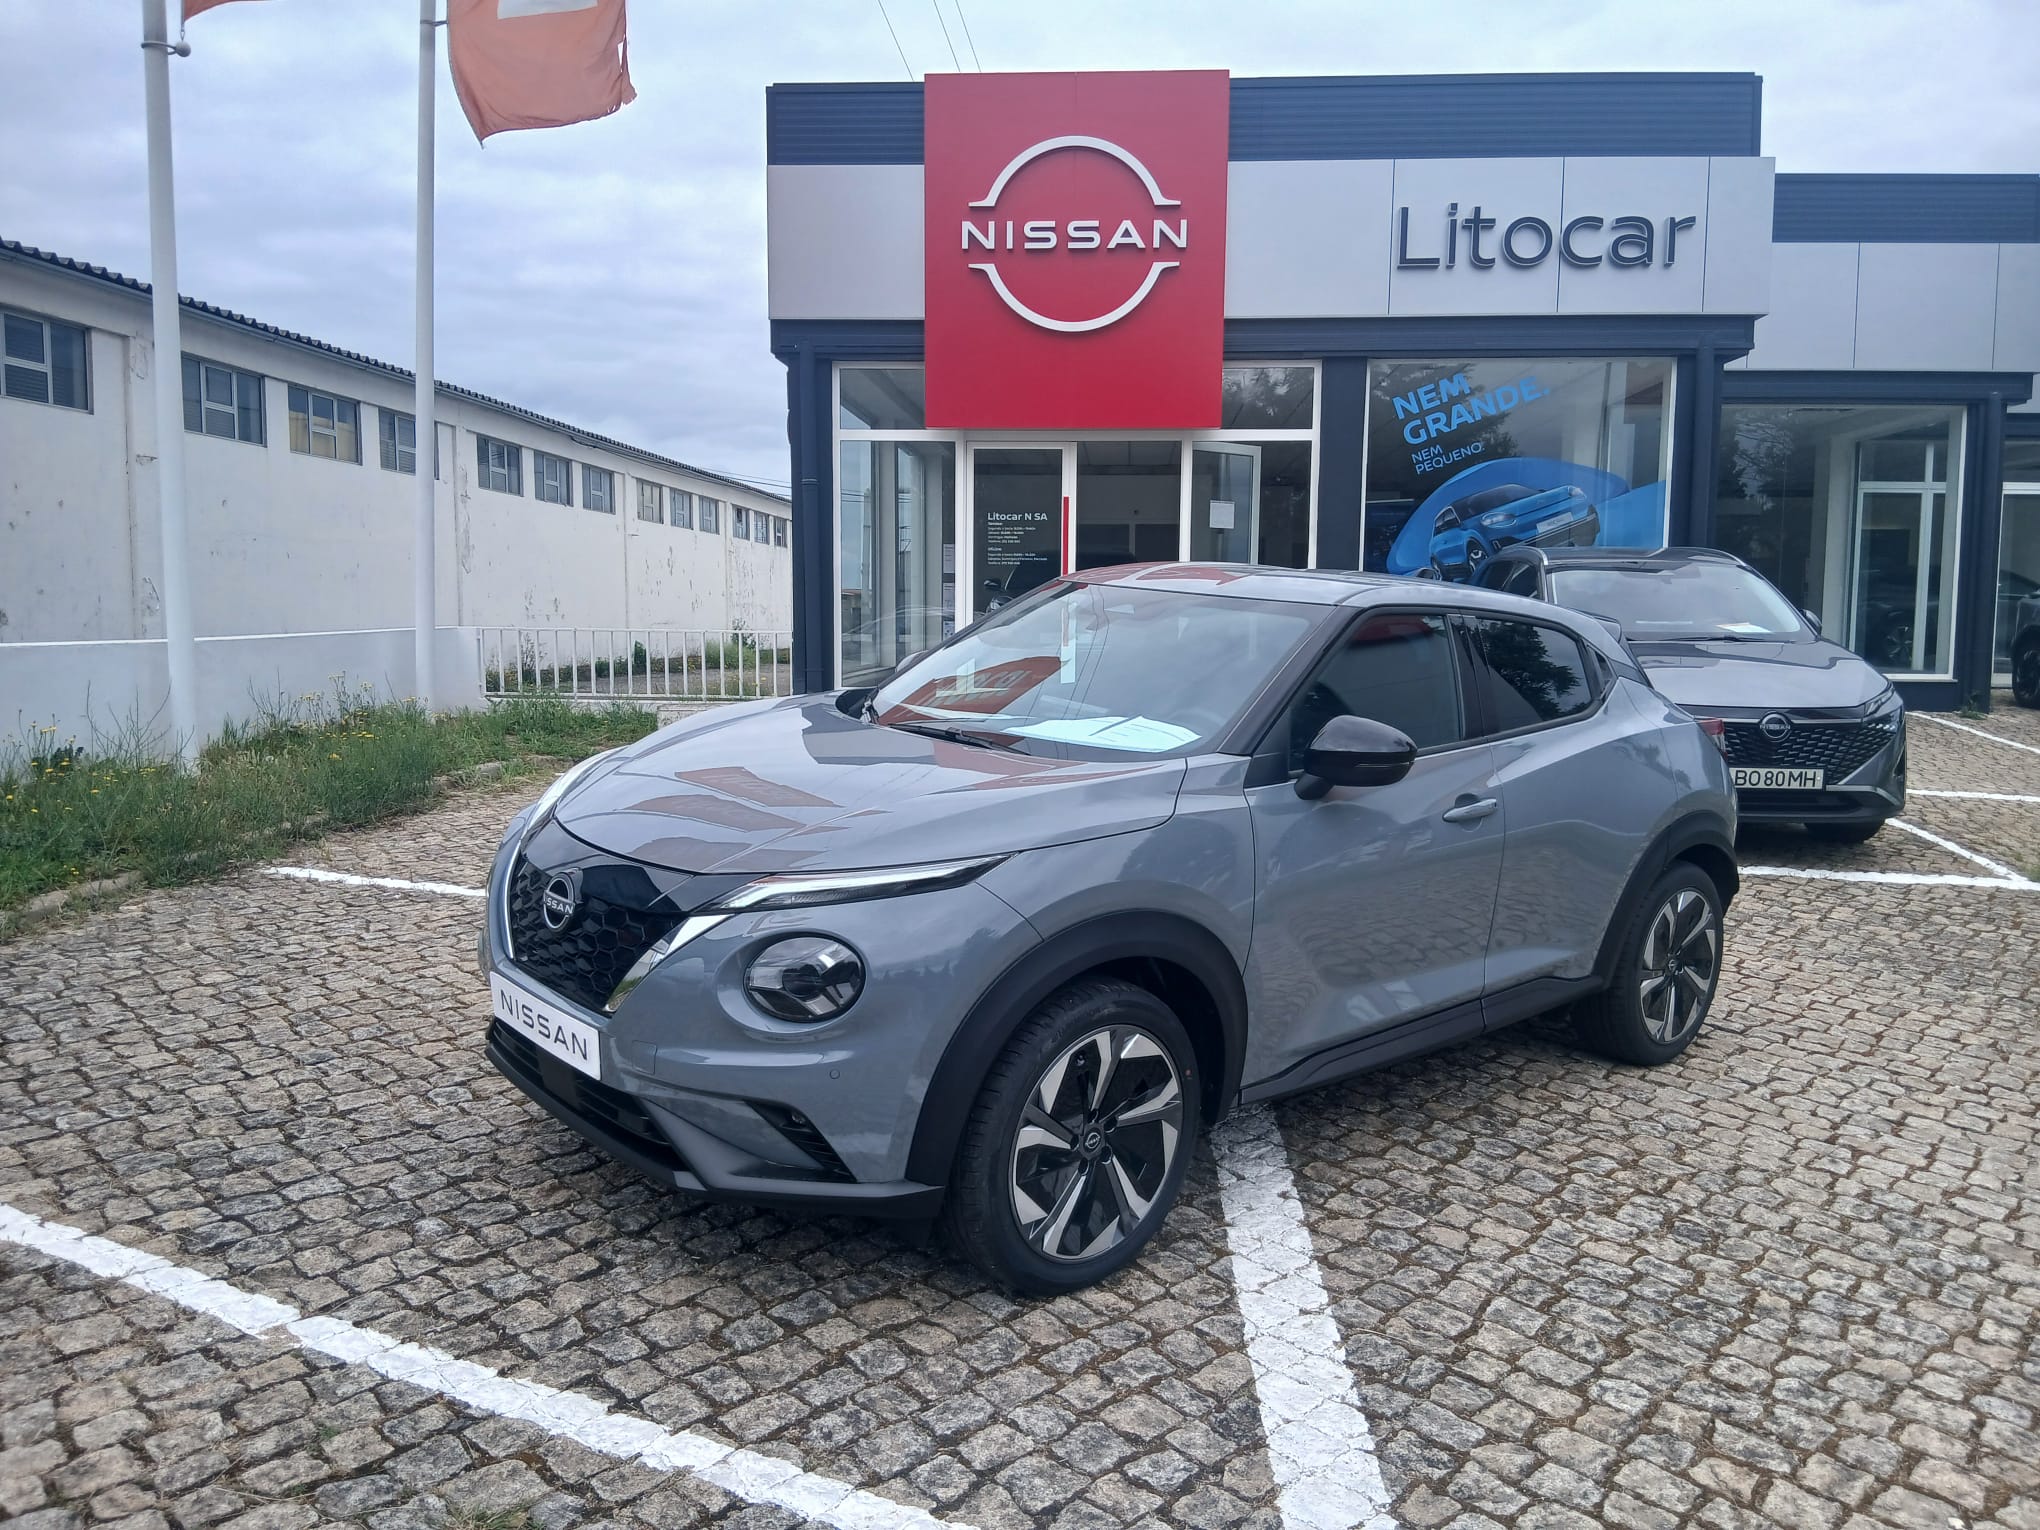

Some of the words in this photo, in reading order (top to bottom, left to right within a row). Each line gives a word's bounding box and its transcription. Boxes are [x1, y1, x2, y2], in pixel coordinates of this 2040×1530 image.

[961, 218, 1188, 251] NISSAN
[1396, 202, 1697, 270] Litocar
[1392, 372, 1471, 420] NEM
[1403, 375, 1550, 445] GRANDE.
[1411, 444, 1443, 464] NEM
[987, 511, 1022, 521] Litocar
[1024, 512, 1032, 521] N
[1034, 512, 1048, 521] SA
[543, 893, 574, 914] SSAN
[500, 989, 588, 1061] NISSAN
